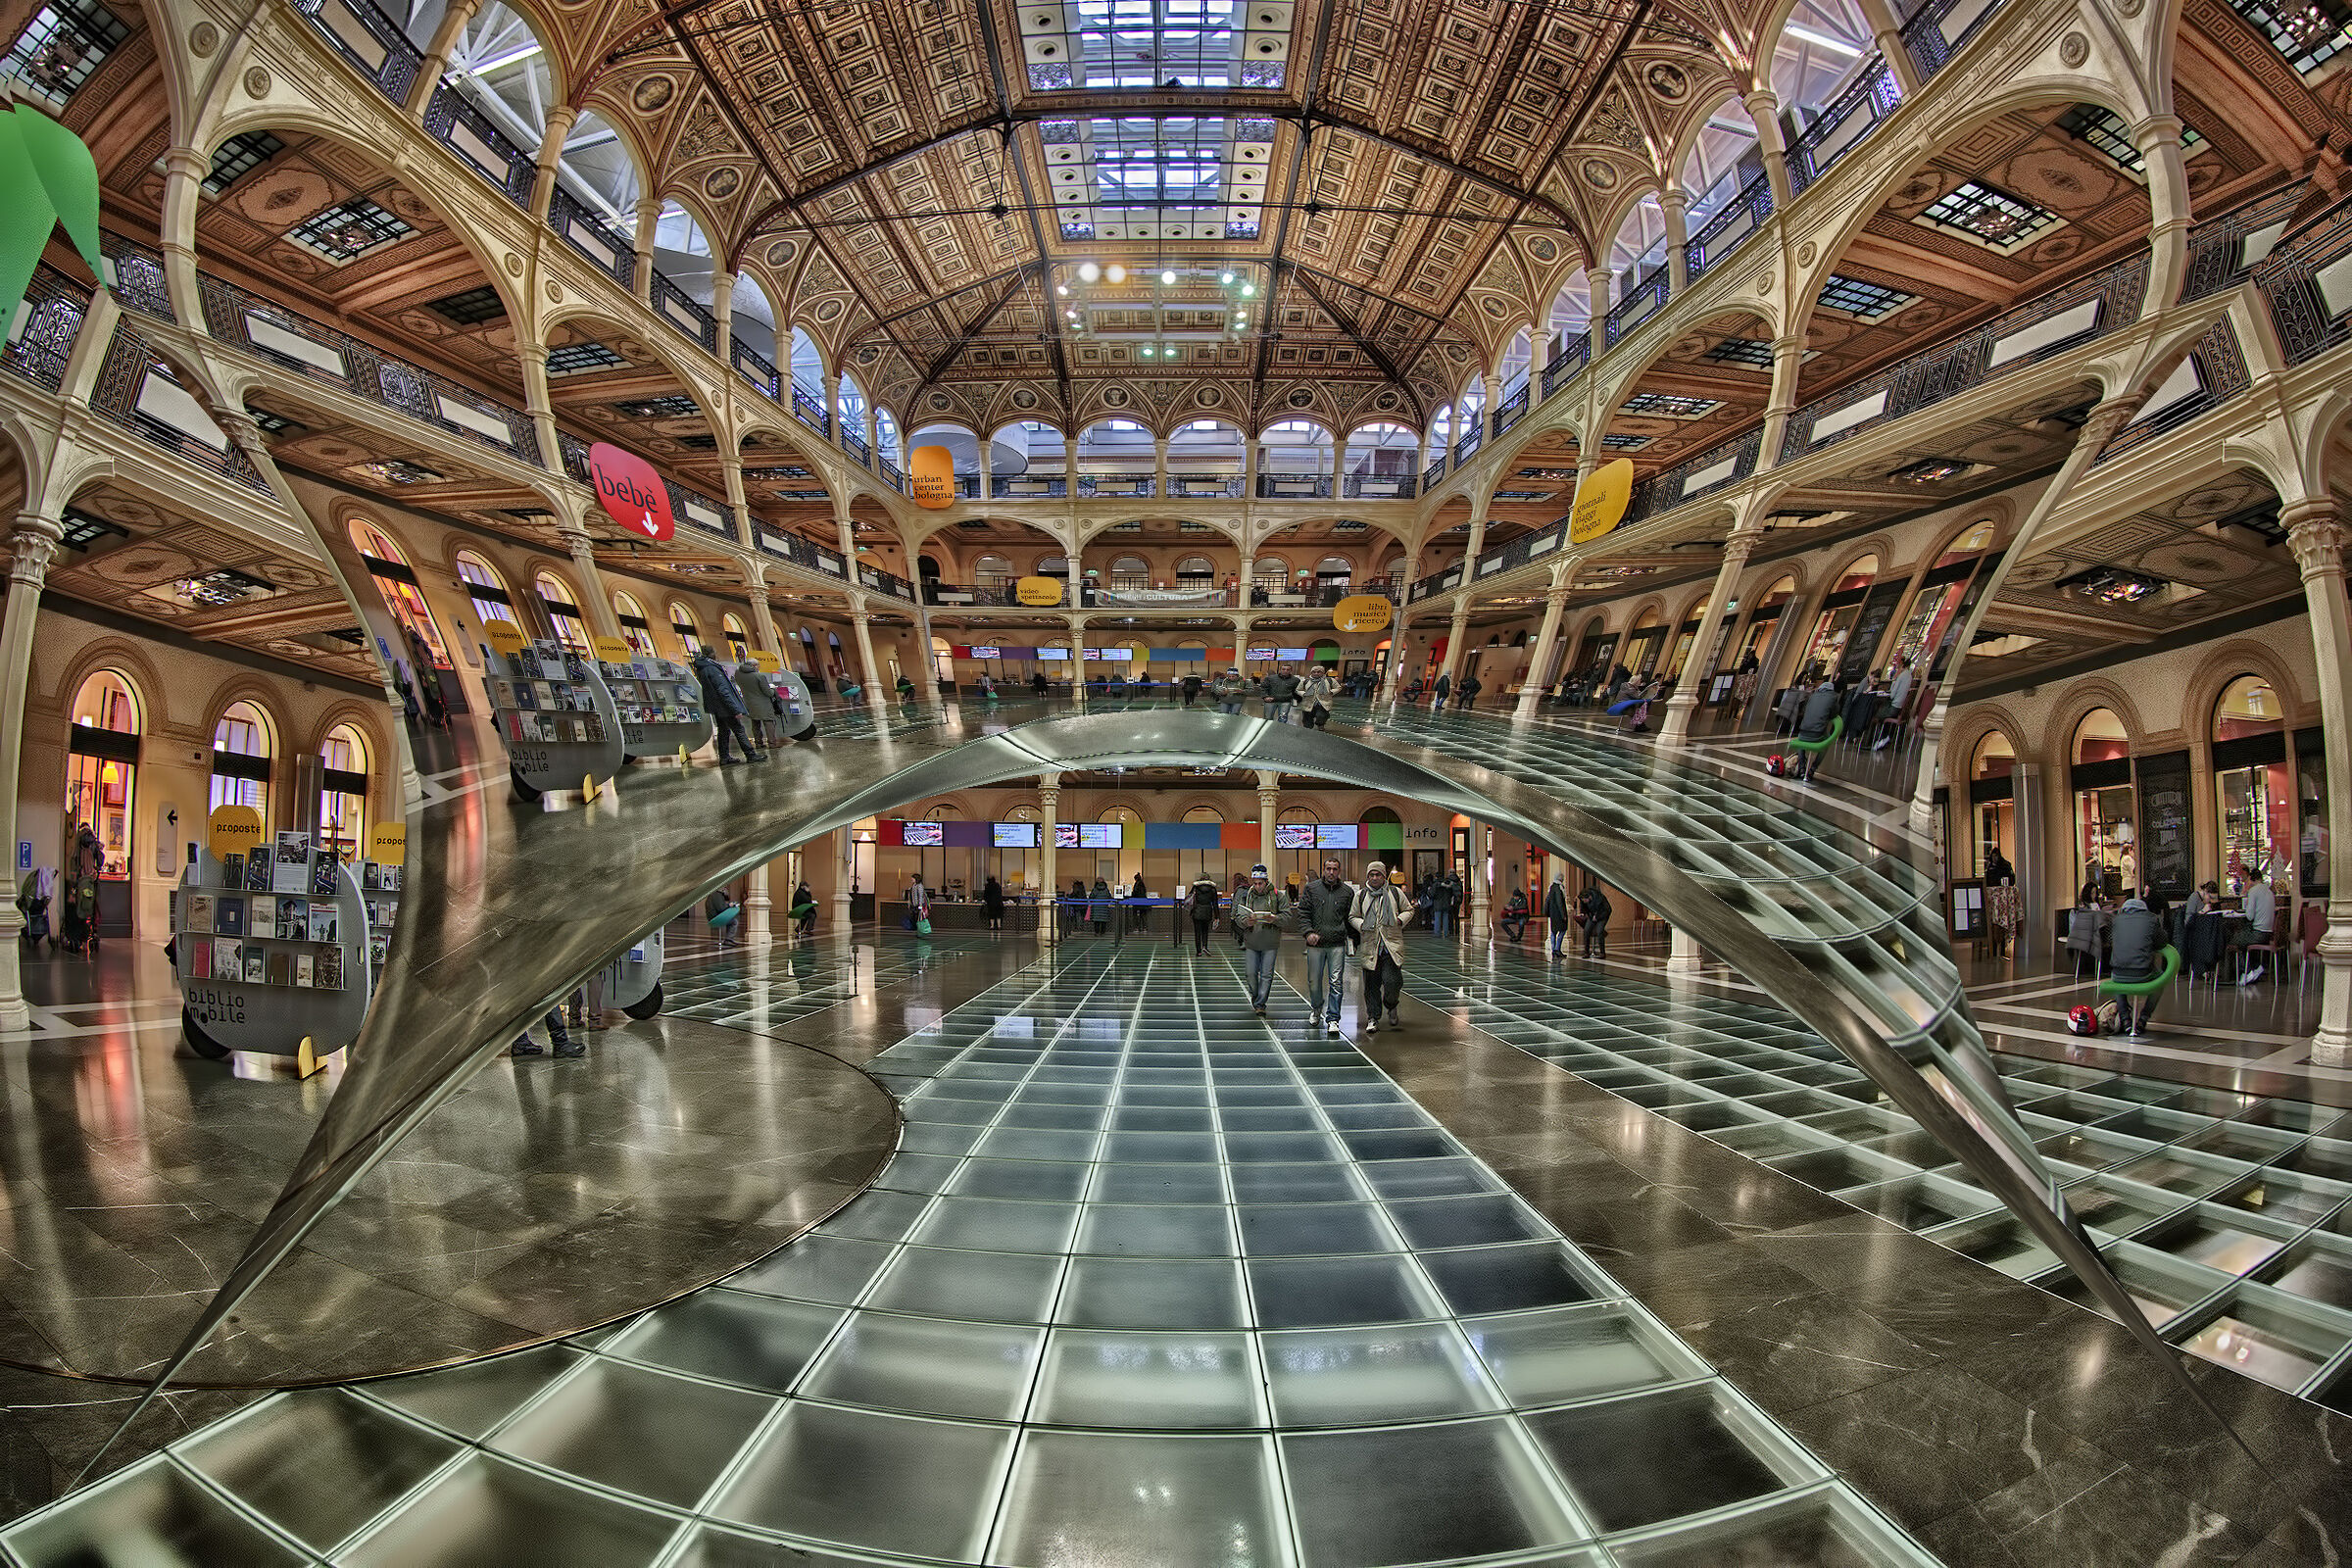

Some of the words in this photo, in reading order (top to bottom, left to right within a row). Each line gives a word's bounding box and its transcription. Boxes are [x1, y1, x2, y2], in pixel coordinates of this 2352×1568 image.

[594, 464, 659, 513] bebè
[914, 491, 954, 501] bologna
[1577, 491, 1606, 515] giornali
[1575, 506, 1596, 525] viaggi
[1573, 518, 1601, 536] bologna
[511, 748, 547, 760] biblio
[217, 823, 261, 834] proposte
[1405, 827, 1438, 839] info
[23, 843, 29, 856] P
[189, 987, 244, 1008] biblio
